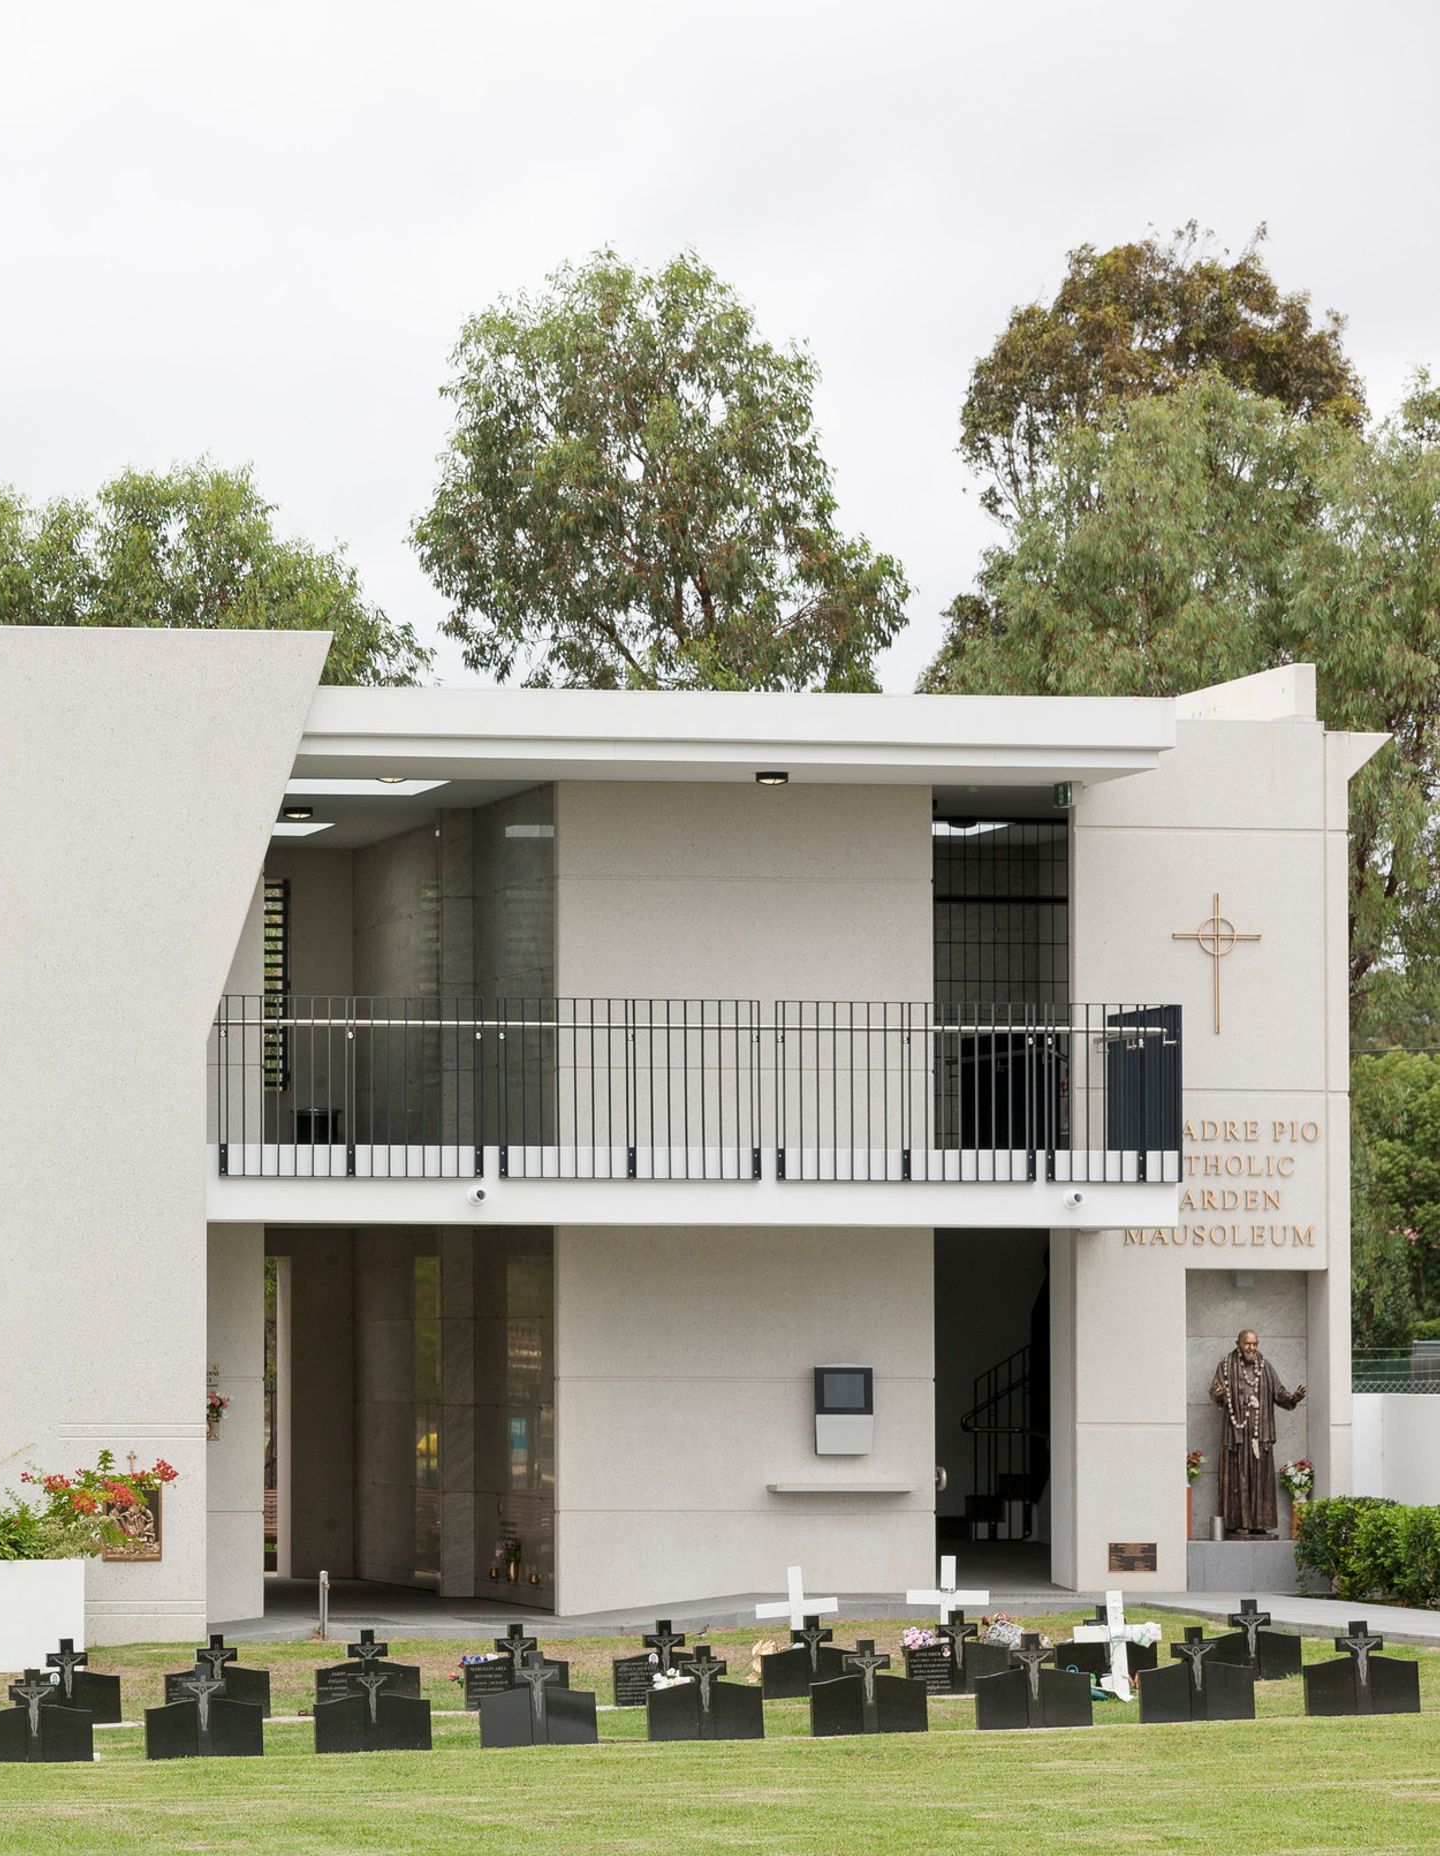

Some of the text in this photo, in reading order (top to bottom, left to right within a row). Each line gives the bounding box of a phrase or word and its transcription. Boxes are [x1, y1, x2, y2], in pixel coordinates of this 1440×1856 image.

[1181, 1119, 1322, 1143] ADRE PIO
[1184, 1154, 1297, 1177] THOLIC
[1178, 1189, 1282, 1211] ARDEN
[1123, 1224, 1316, 1247] MAUSOLEUM
